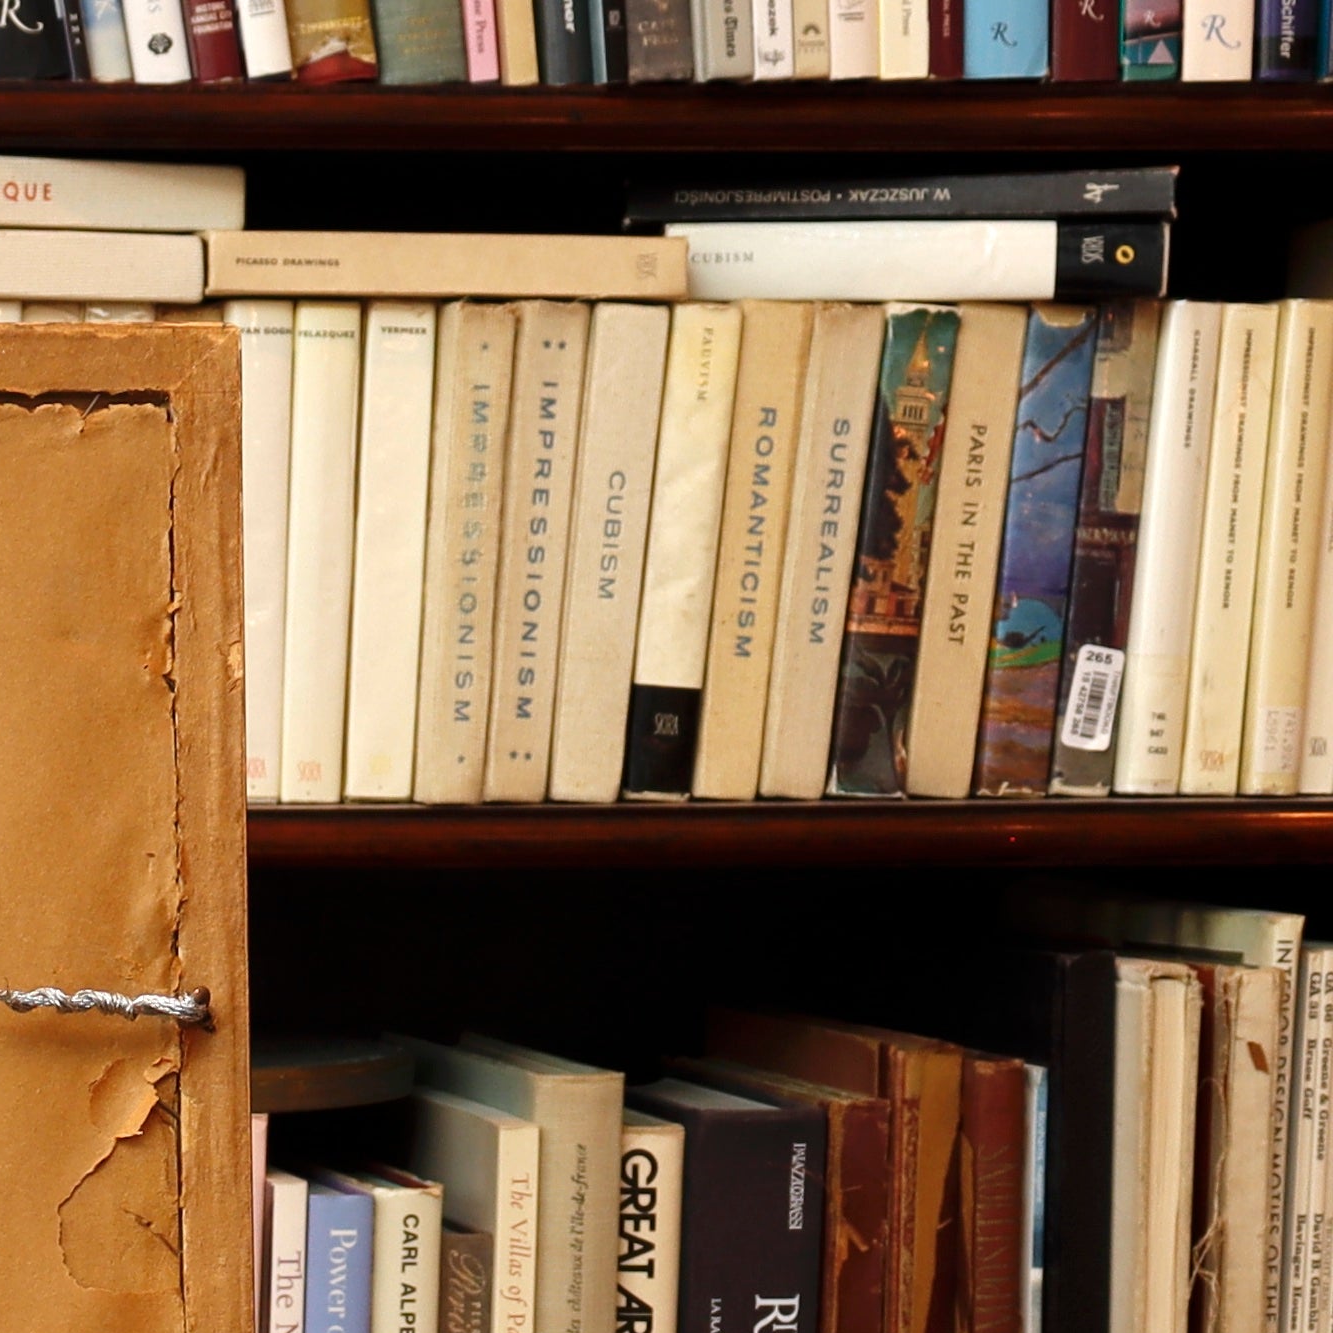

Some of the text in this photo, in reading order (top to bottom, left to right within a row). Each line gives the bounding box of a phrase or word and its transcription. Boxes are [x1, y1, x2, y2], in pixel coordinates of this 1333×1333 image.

[991, 22, 1018, 47] R
[1201, 14, 1241, 49] R
[1279, 0, 1296, 59] Schiffer
[848, 187, 929, 204] JUSZCZAK
[234, 256, 341, 269] PICASSO DRAWINGS
[689, 250, 755, 265] CUBISM
[380, 325, 428, 336] VERMEER
[695, 326, 715, 403] FAUVISM
[1184, 329, 1202, 449] CHAGALL DRAWINGS
[1234, 328, 1254, 469] IMPRESSIONIST DRAWINGS
[1297, 327, 1316, 468] IMPRESSIONIST DRAWINGS
[453, 383, 491, 722] IMPRESSIONISM
[515, 380, 560, 720] IMPRESSIONISM
[597, 470, 627, 600] CUBISM
[733, 405, 779, 659] ROMANTICISM
[808, 417, 851, 646] SURREALISM
[948, 423, 988, 647] PARIS IN THE PAST
[1085, 650, 1114, 665] 265
[1302, 971, 1321, 1121] GA Bruce Goff
[1316, 1037, 1332, 1161] Greene Greene
[510, 1172, 531, 1210] The
[618, 1147, 659, 1280] GREAT
[401, 1212, 420, 1274] CARL
[507, 1218, 532, 1279] Villas
[1292, 1213, 1307, 1279] Bavinger
[1311, 1212, 1323, 1254] David
[277, 1250, 303, 1309] The
[328, 1227, 359, 1315] Power
[500, 1283, 527, 1307] of
[710, 1297, 722, 1314] LA
[1264, 1284, 1278, 1323] THE
[1290, 1286, 1303, 1330] House
[1307, 1276, 1320, 1331] Gamble
